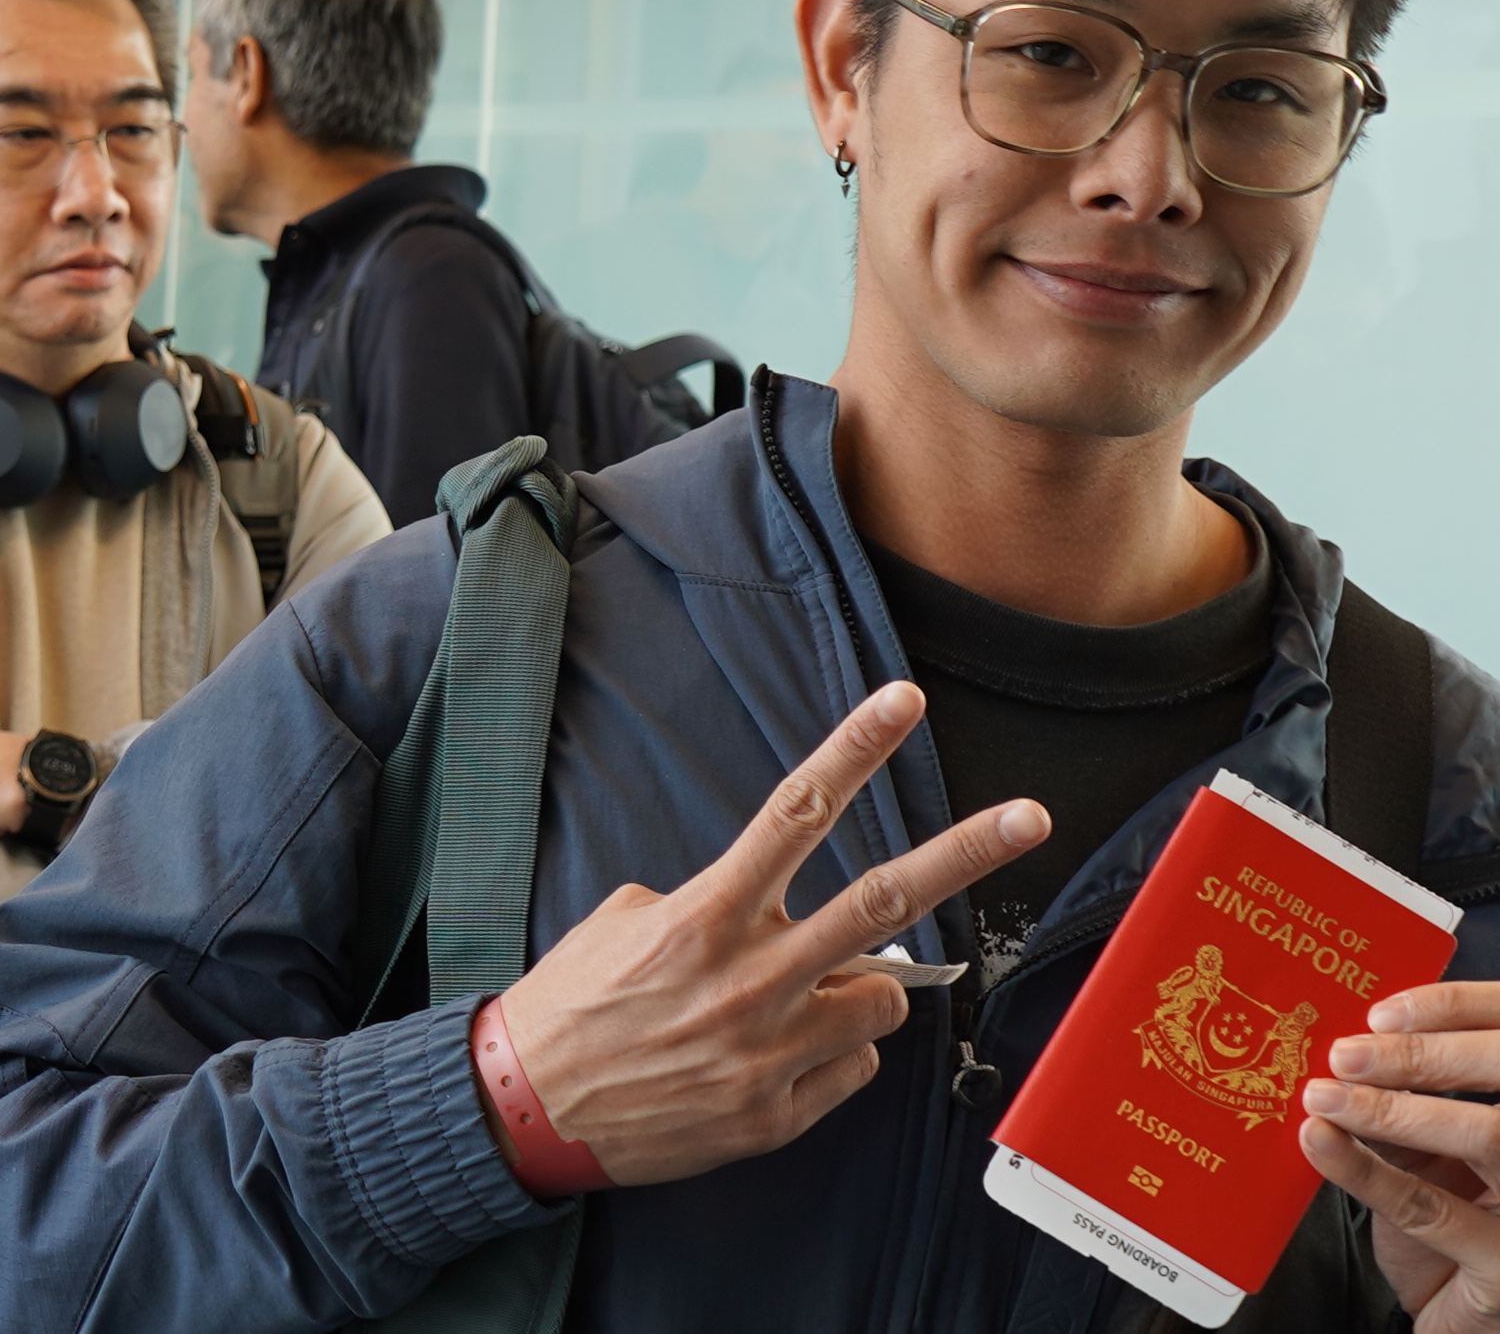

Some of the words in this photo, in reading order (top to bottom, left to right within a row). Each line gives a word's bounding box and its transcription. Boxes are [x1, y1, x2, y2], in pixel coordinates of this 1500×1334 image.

[1196, 876, 1380, 1000] SINGAPORE
[1235, 866, 1338, 938] REPUBLIC
[1339, 928, 1371, 953] OF
[1147, 1030, 1193, 1081] MAJULAH
[1196, 1080, 1274, 1110] SINGAPURA
[1116, 1099, 1226, 1173] PASSPORT
[1073, 1212, 1107, 1239] PASS
[1107, 1234, 1179, 1283] BOARDING
